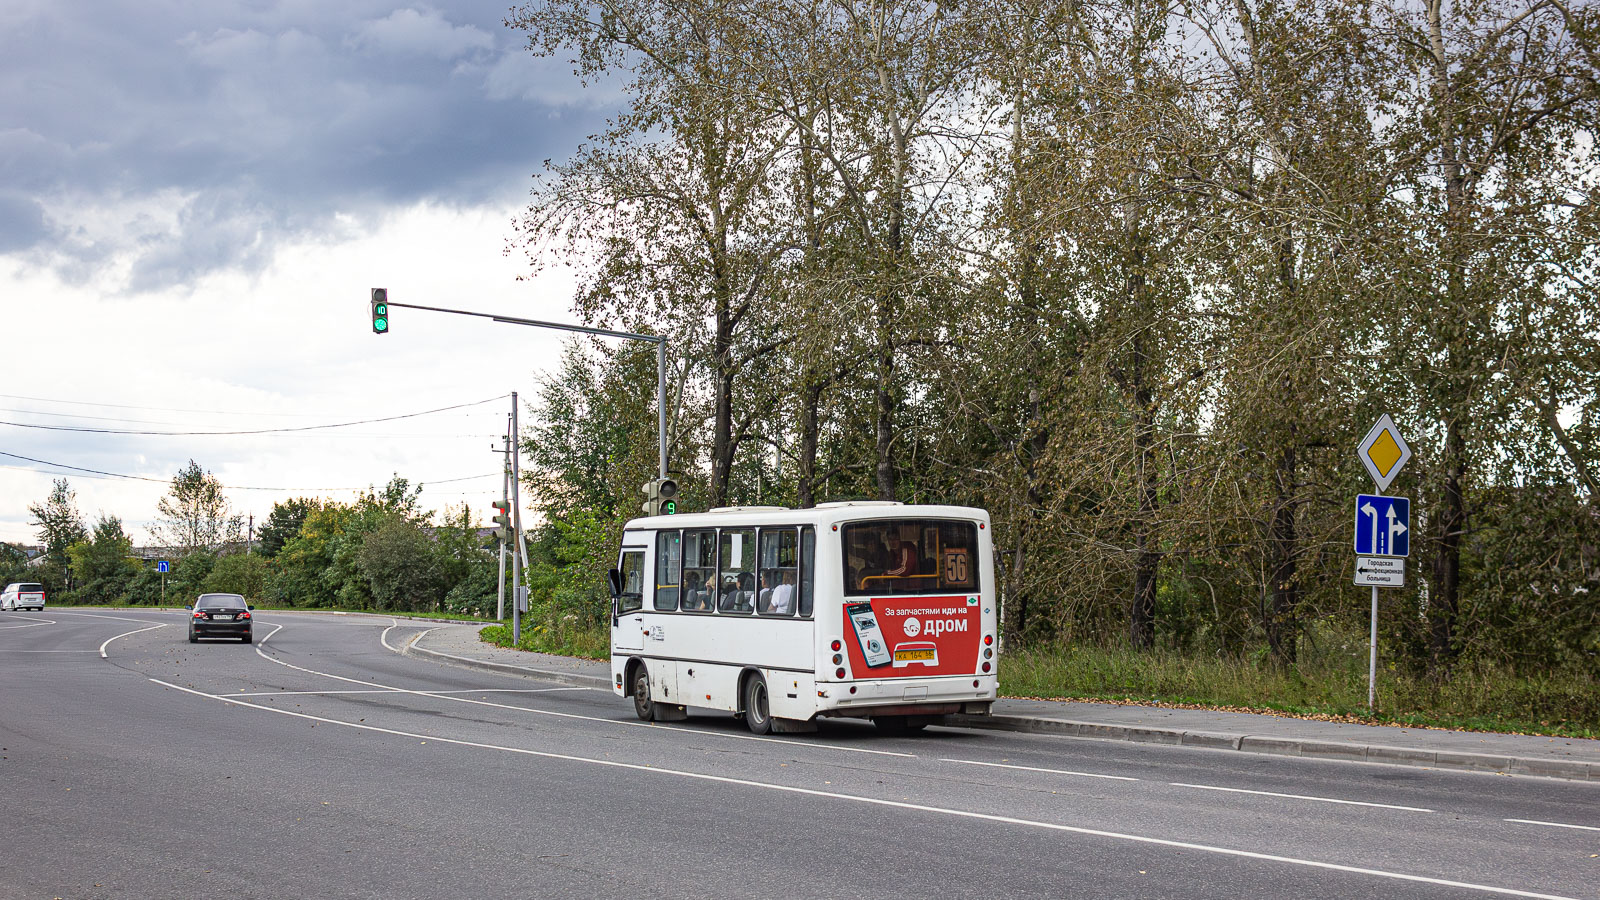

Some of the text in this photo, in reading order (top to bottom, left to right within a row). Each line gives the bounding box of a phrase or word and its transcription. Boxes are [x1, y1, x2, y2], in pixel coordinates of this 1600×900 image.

[377, 306, 386, 315] 10
[668, 502, 675, 514] 9
[947, 554, 966, 581] 56
[885, 607, 895, 616] За
[896, 607, 940, 616] запчастями
[942, 607, 957, 616] иди
[924, 619, 967, 637] дром
